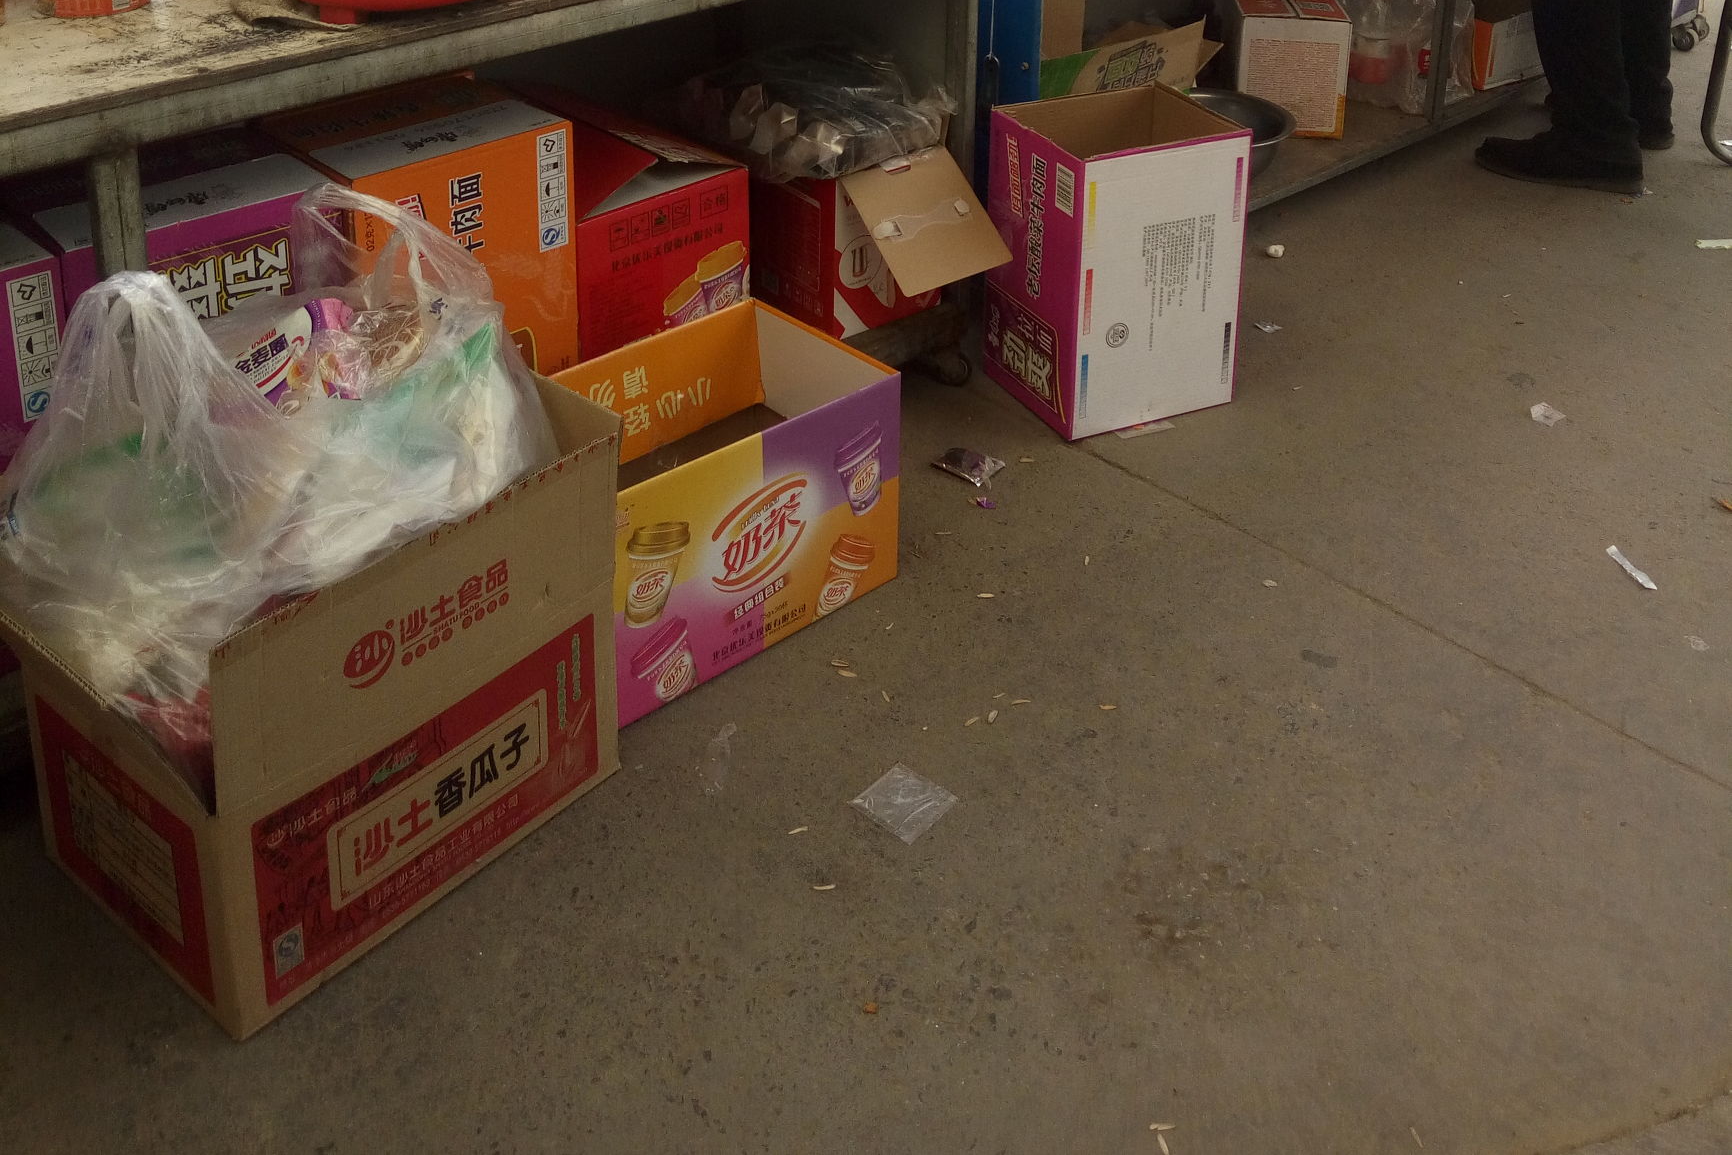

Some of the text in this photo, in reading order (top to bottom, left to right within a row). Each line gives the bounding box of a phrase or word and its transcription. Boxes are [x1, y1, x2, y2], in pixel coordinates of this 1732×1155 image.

[1026, 154, 1048, 298] 老坛酸菜牛肉面
[1002, 326, 1053, 399] 劲爽
[721, 491, 803, 581] 奶茶
[400, 558, 509, 646] 沙土食品
[635, 576, 665, 597] 奶茶
[734, 577, 784, 620] 经典组合装
[823, 584, 850, 601] 奶茶
[663, 660, 688, 692] 奶茶
[353, 723, 530, 877] 沙土香瓜子
